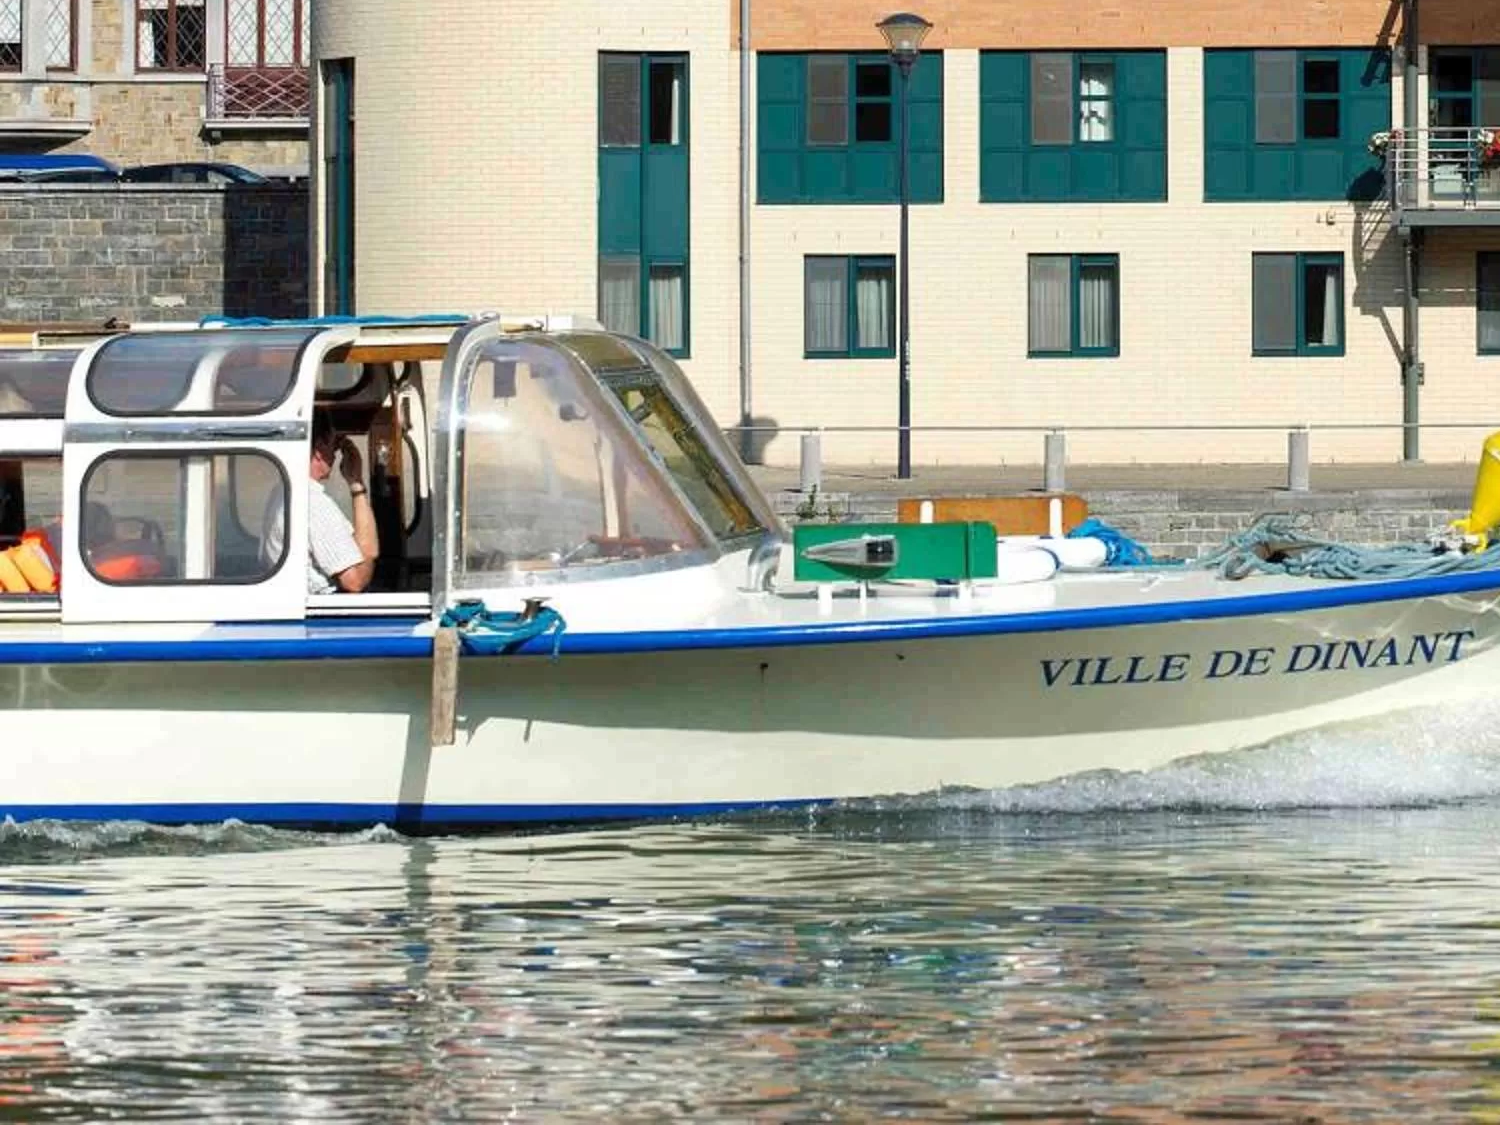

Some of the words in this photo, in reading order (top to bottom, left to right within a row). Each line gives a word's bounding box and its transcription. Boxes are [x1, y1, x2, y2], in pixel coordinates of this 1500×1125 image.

[1039, 653, 1192, 688] VILLE
[1204, 647, 1276, 679] DE
[1283, 630, 1476, 674] DINANT
